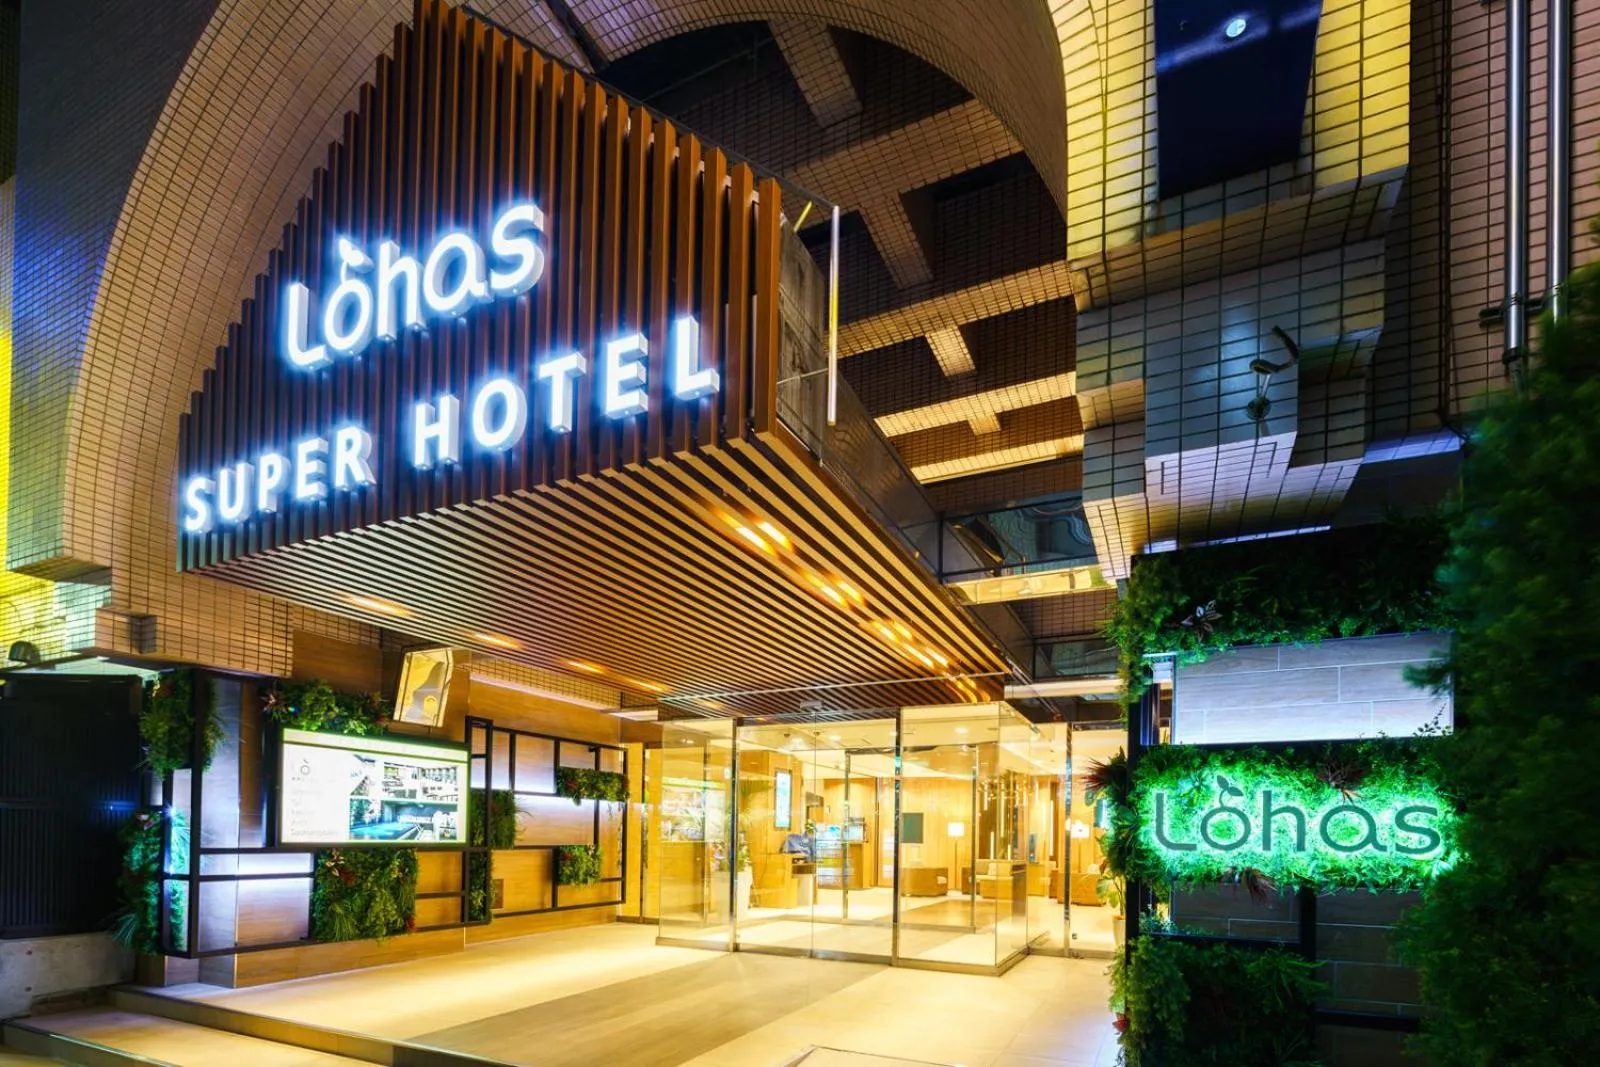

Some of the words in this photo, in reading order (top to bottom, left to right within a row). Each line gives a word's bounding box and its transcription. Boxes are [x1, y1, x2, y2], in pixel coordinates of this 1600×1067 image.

[283, 203, 546, 371] Lohas
[184, 424, 377, 534] SUPER
[411, 314, 721, 471] HOTEL
[1154, 774, 1442, 856] Lohas
